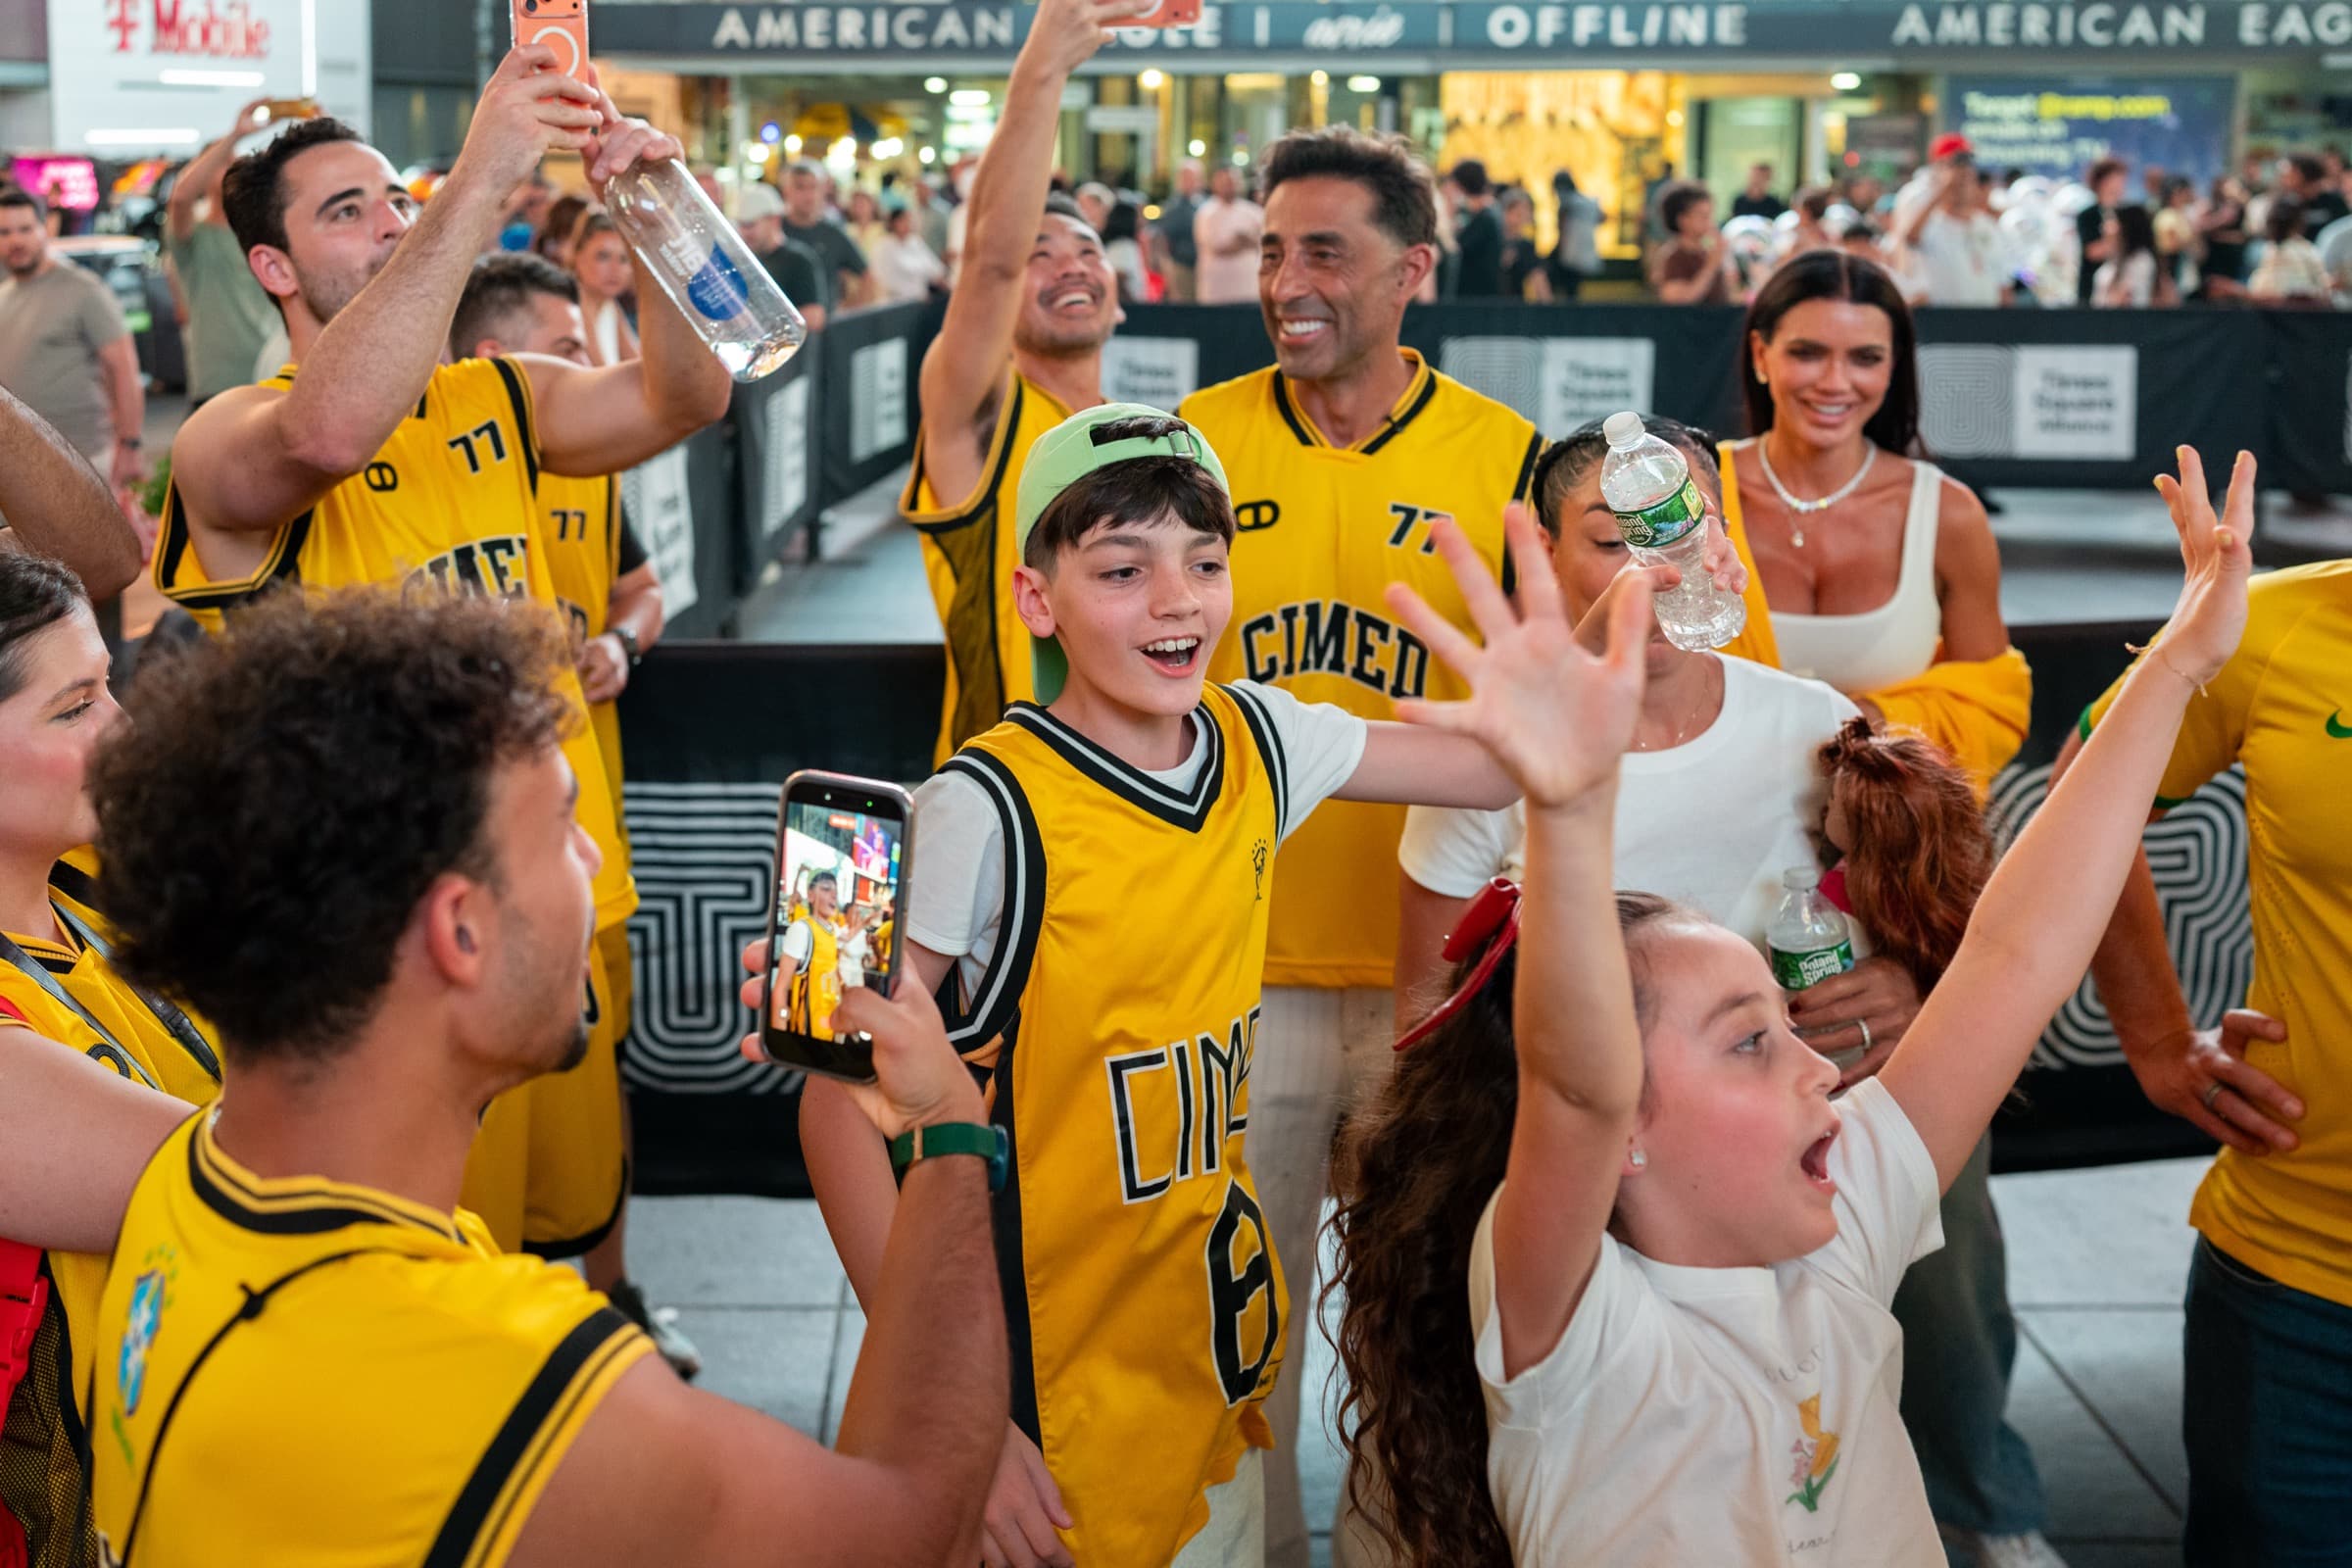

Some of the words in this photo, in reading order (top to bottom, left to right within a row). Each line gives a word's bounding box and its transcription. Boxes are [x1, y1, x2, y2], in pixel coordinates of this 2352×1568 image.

[711, 7, 1015, 48] AMERICAN
[1487, 5, 1748, 47] OFFLINE
[1891, 4, 2205, 46] AMERICAN
[2238, 3, 2352, 45] EAG
[448, 419, 506, 474] 77
[551, 509, 586, 542] 77
[1241, 600, 1431, 699] CIMED
[1798, 950, 1838, 973] Poland
[1802, 962, 1842, 986] Spring
